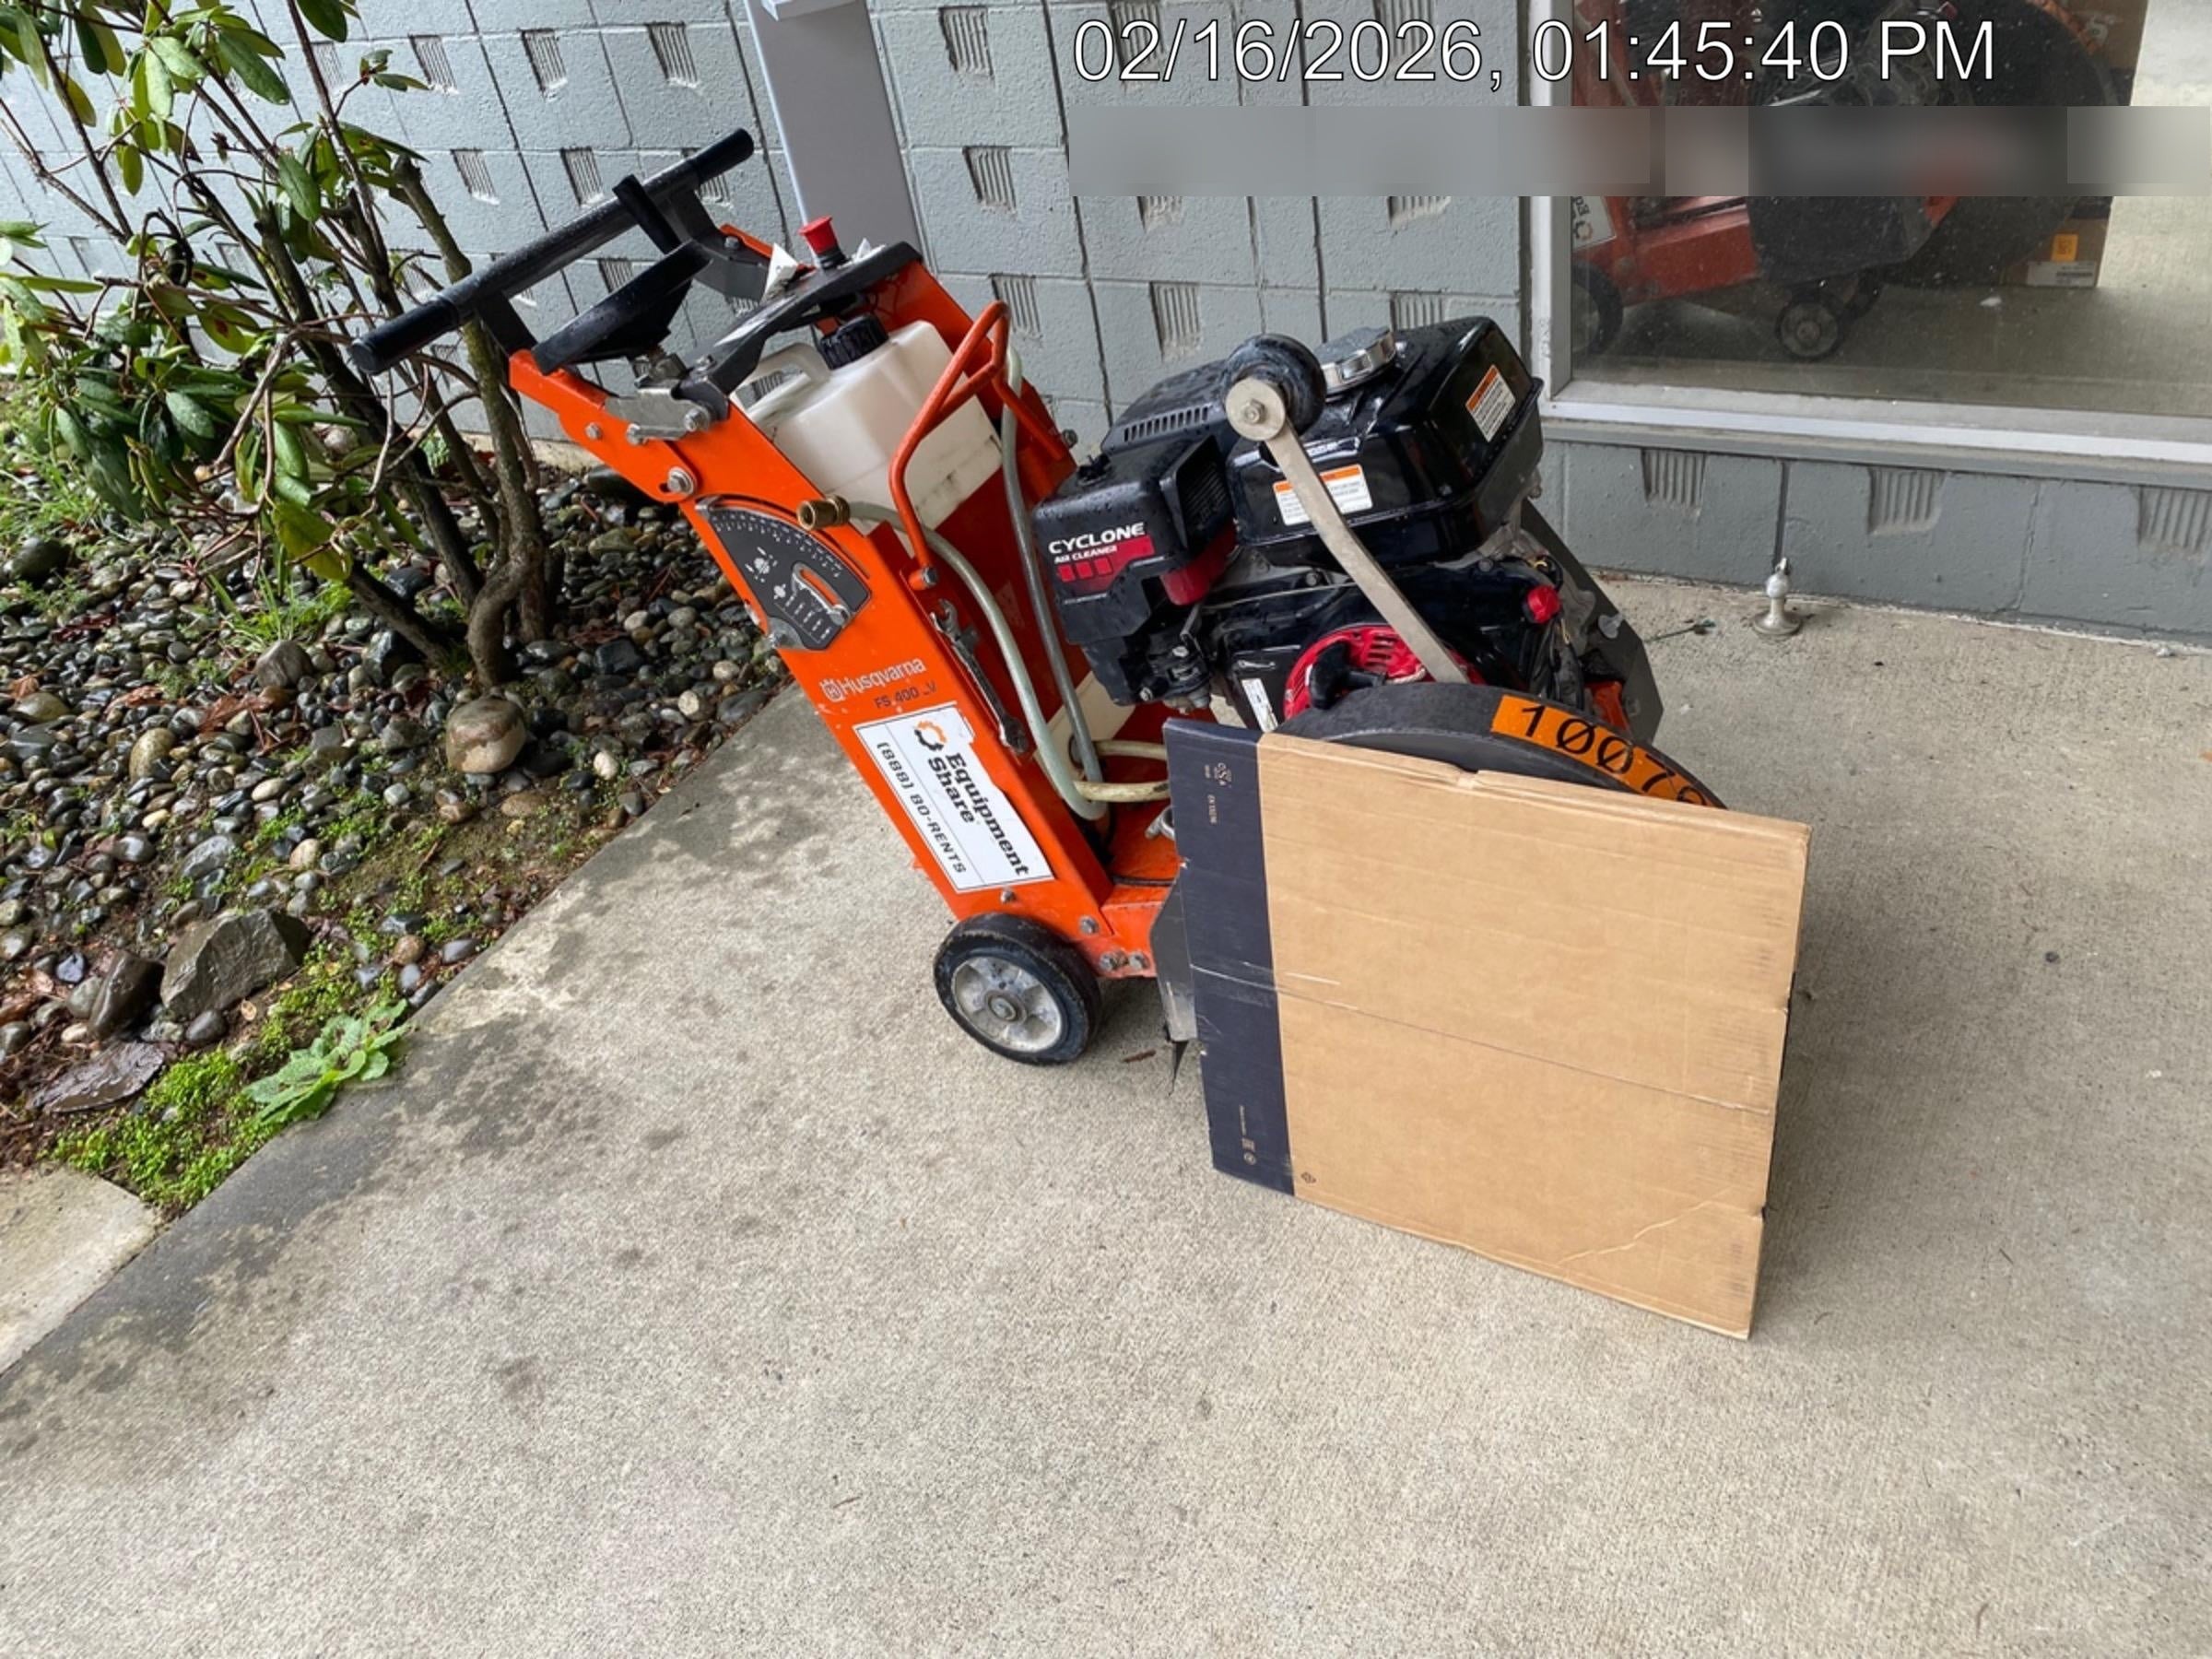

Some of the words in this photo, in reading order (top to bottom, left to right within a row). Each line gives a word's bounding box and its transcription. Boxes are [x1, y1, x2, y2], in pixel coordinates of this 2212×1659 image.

[1048, 522, 1146, 554] CYCLONE
[1053, 554, 1071, 564] AIR
[1072, 545, 1118, 560] CLEANER
[838, 658, 927, 695] Husqvarna
[874, 695, 892, 709] FS
[895, 687, 920, 702] 400
[877, 742, 914, 790] (888)
[928, 757, 976, 823] Share
[946, 752, 1030, 876] Equipment
